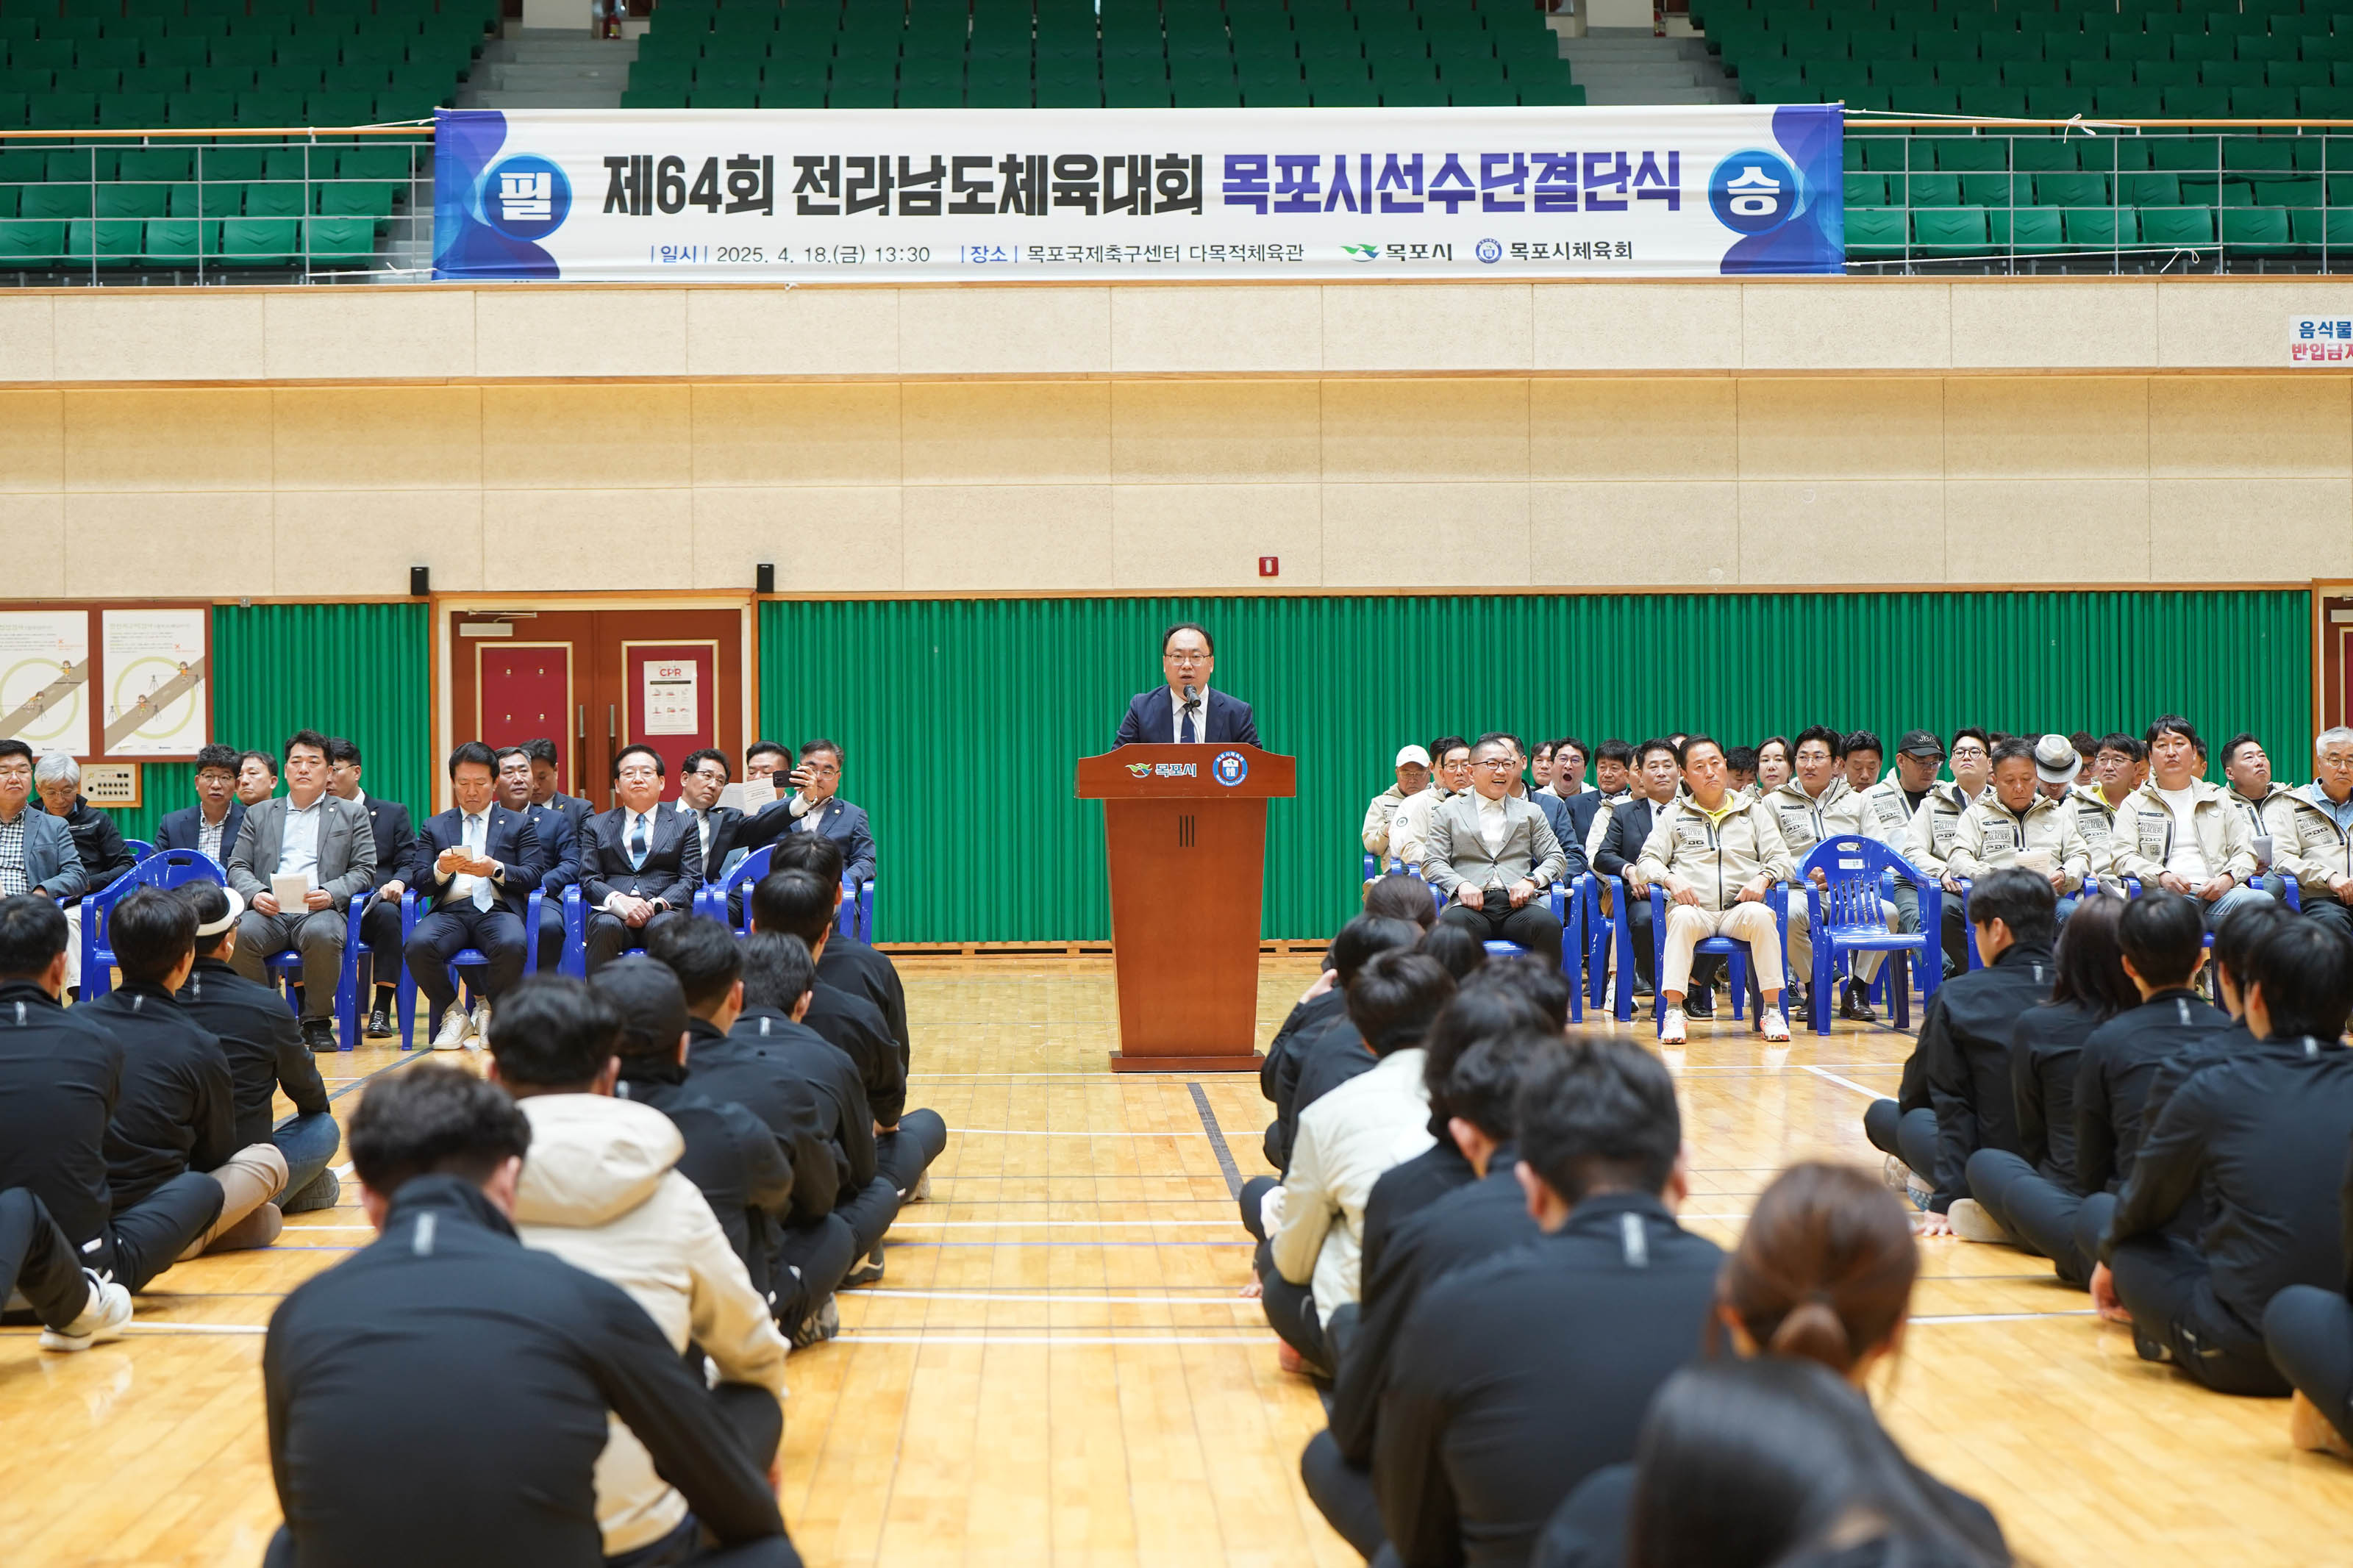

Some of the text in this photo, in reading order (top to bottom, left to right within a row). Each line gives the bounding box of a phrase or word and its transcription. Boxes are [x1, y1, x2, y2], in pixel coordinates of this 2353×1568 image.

[603, 151, 1680, 216] 제64회 전라남도체육대회 목포시선수단결단식
[1727, 166, 1780, 216] 승
[499, 172, 552, 221] 필
[661, 244, 1304, 265] 일시 2025. 4. 18.(금) 13:30 장소 목포국제축구센터 다목적체육관
[1385, 243, 1452, 262] 목포시
[1510, 241, 1633, 261] 목포시체육회
[2299, 321, 2352, 339] 음식물
[660, 668, 682, 677] CPR
[1155, 763, 1197, 777] 목포시
